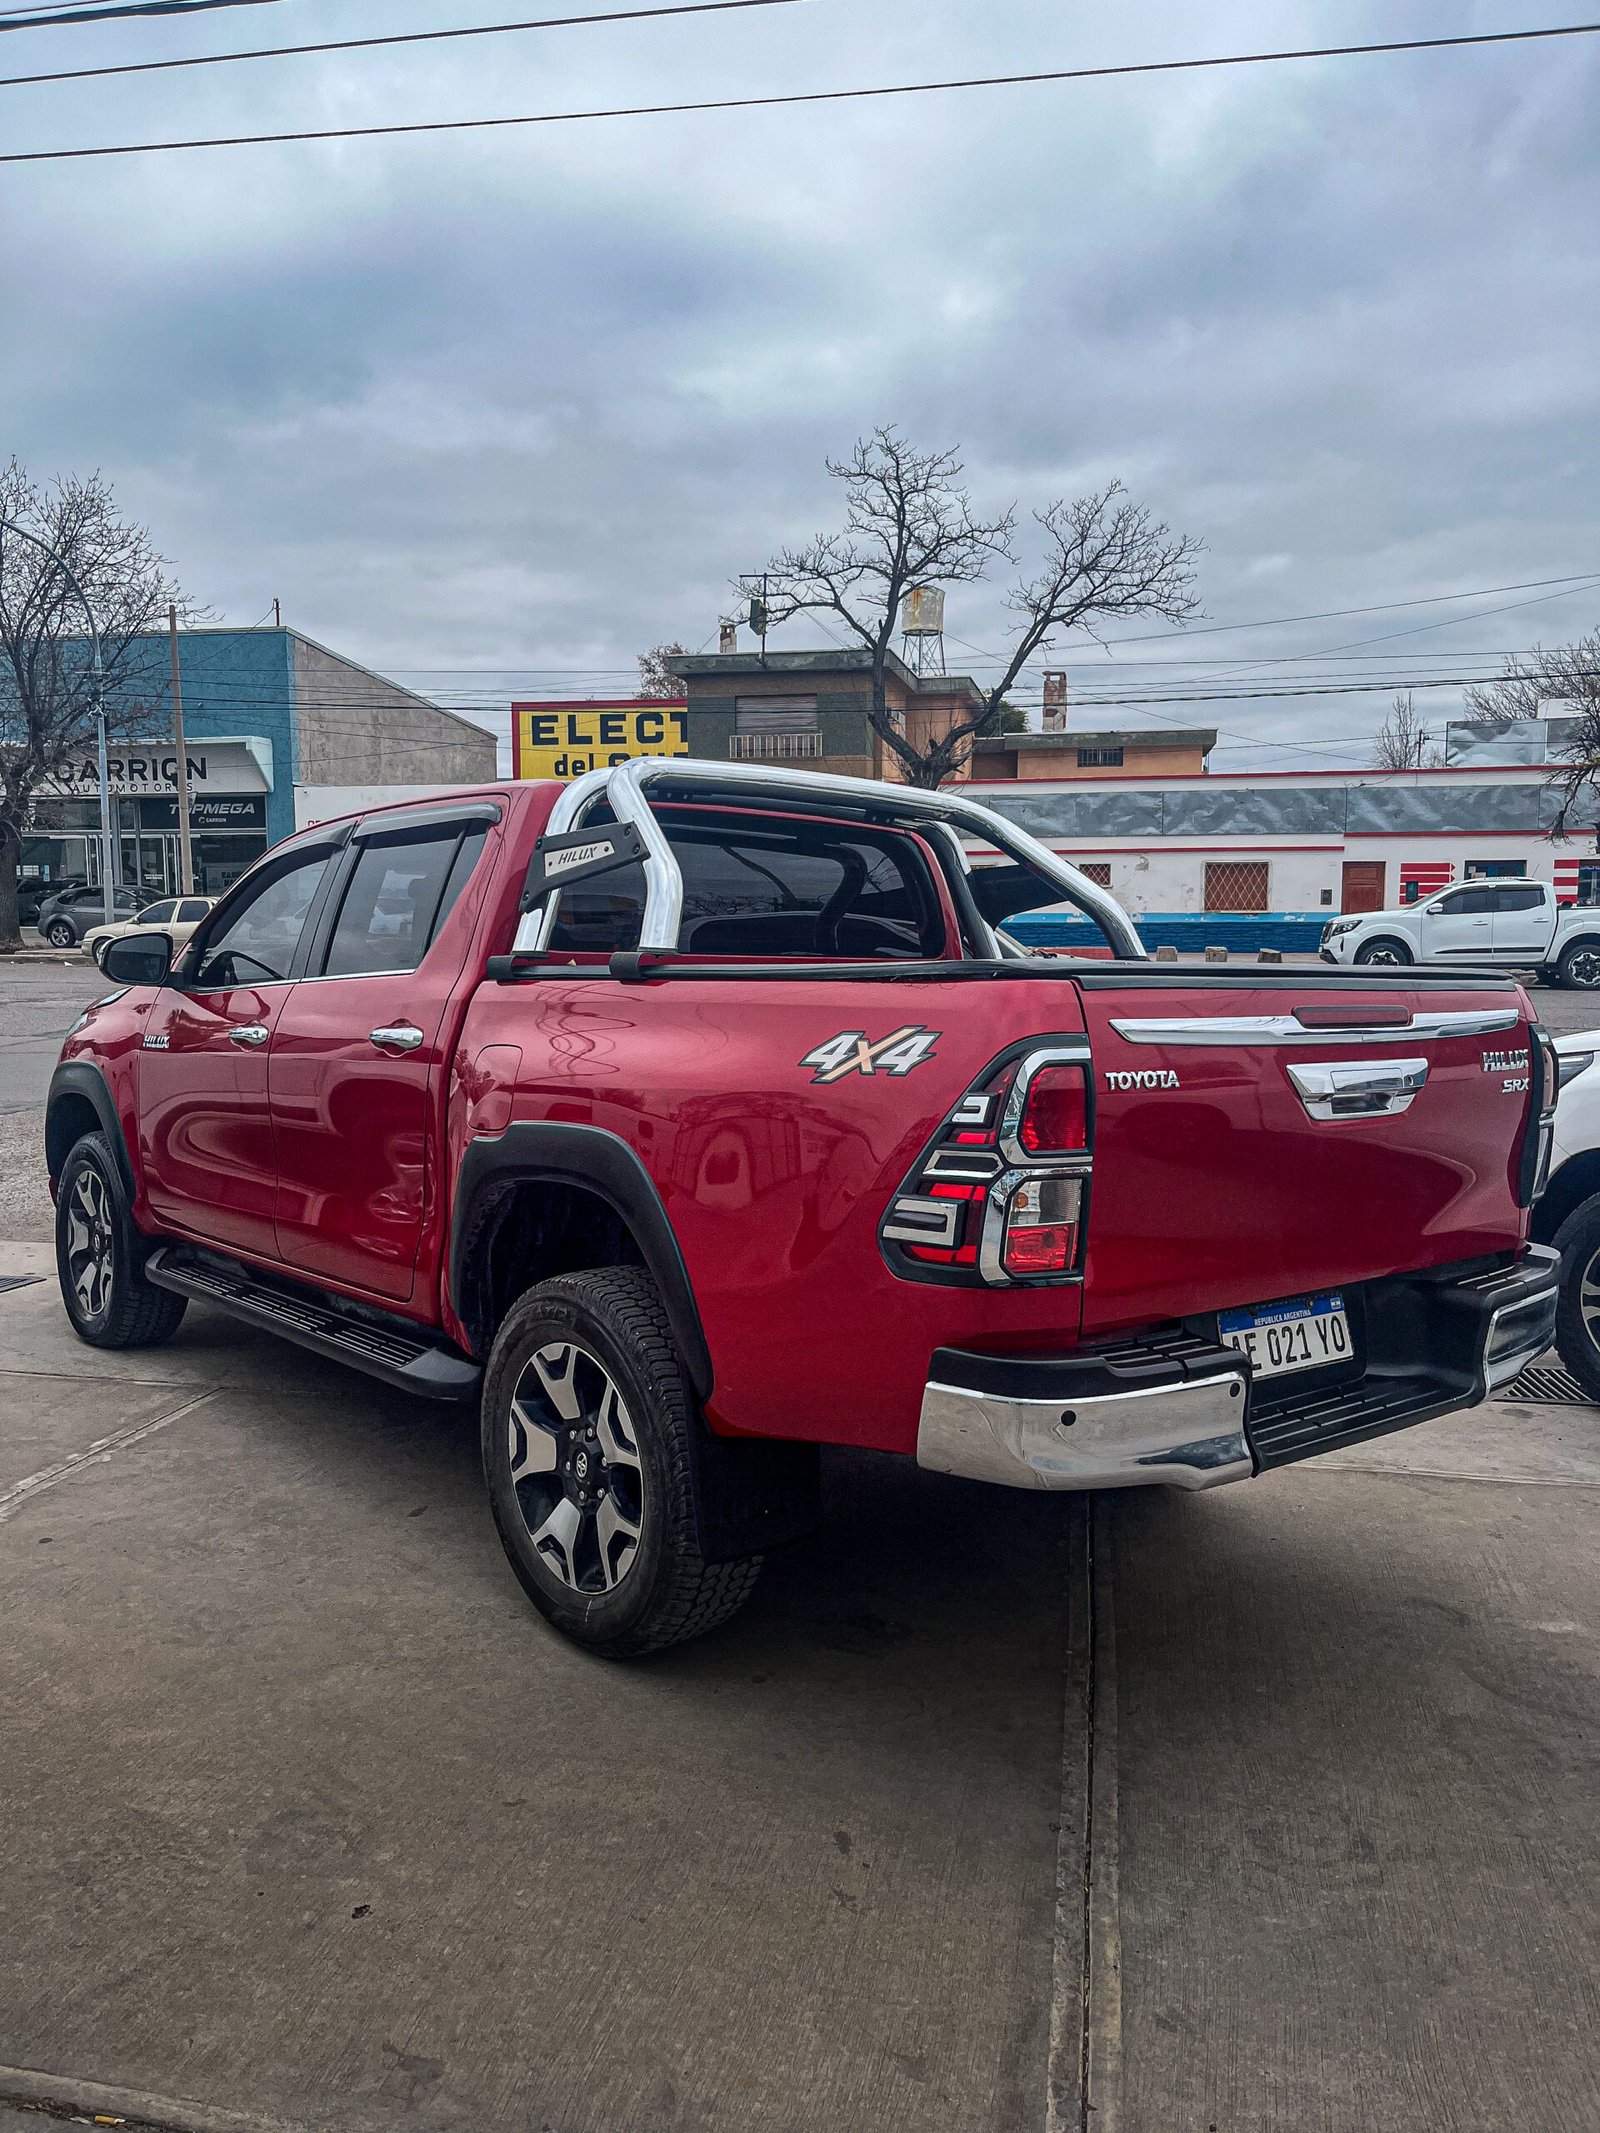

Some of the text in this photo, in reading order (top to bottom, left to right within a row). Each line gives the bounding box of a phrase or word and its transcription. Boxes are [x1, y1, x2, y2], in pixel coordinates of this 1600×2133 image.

[554, 753, 594, 777] del
[72, 782, 193, 794] AUTOMOTORS
[169, 803, 255, 815] TPMEGA
[557, 846, 598, 865] HILUX
[1482, 1048, 1530, 1072] HILUX
[1105, 1070, 1181, 1091] TOYOTA
[1501, 1077, 1530, 1094] SRX
[1253, 1309, 1312, 1327] REPUBLICA ARGENTINA
[1266, 1322, 1312, 1367] 021
